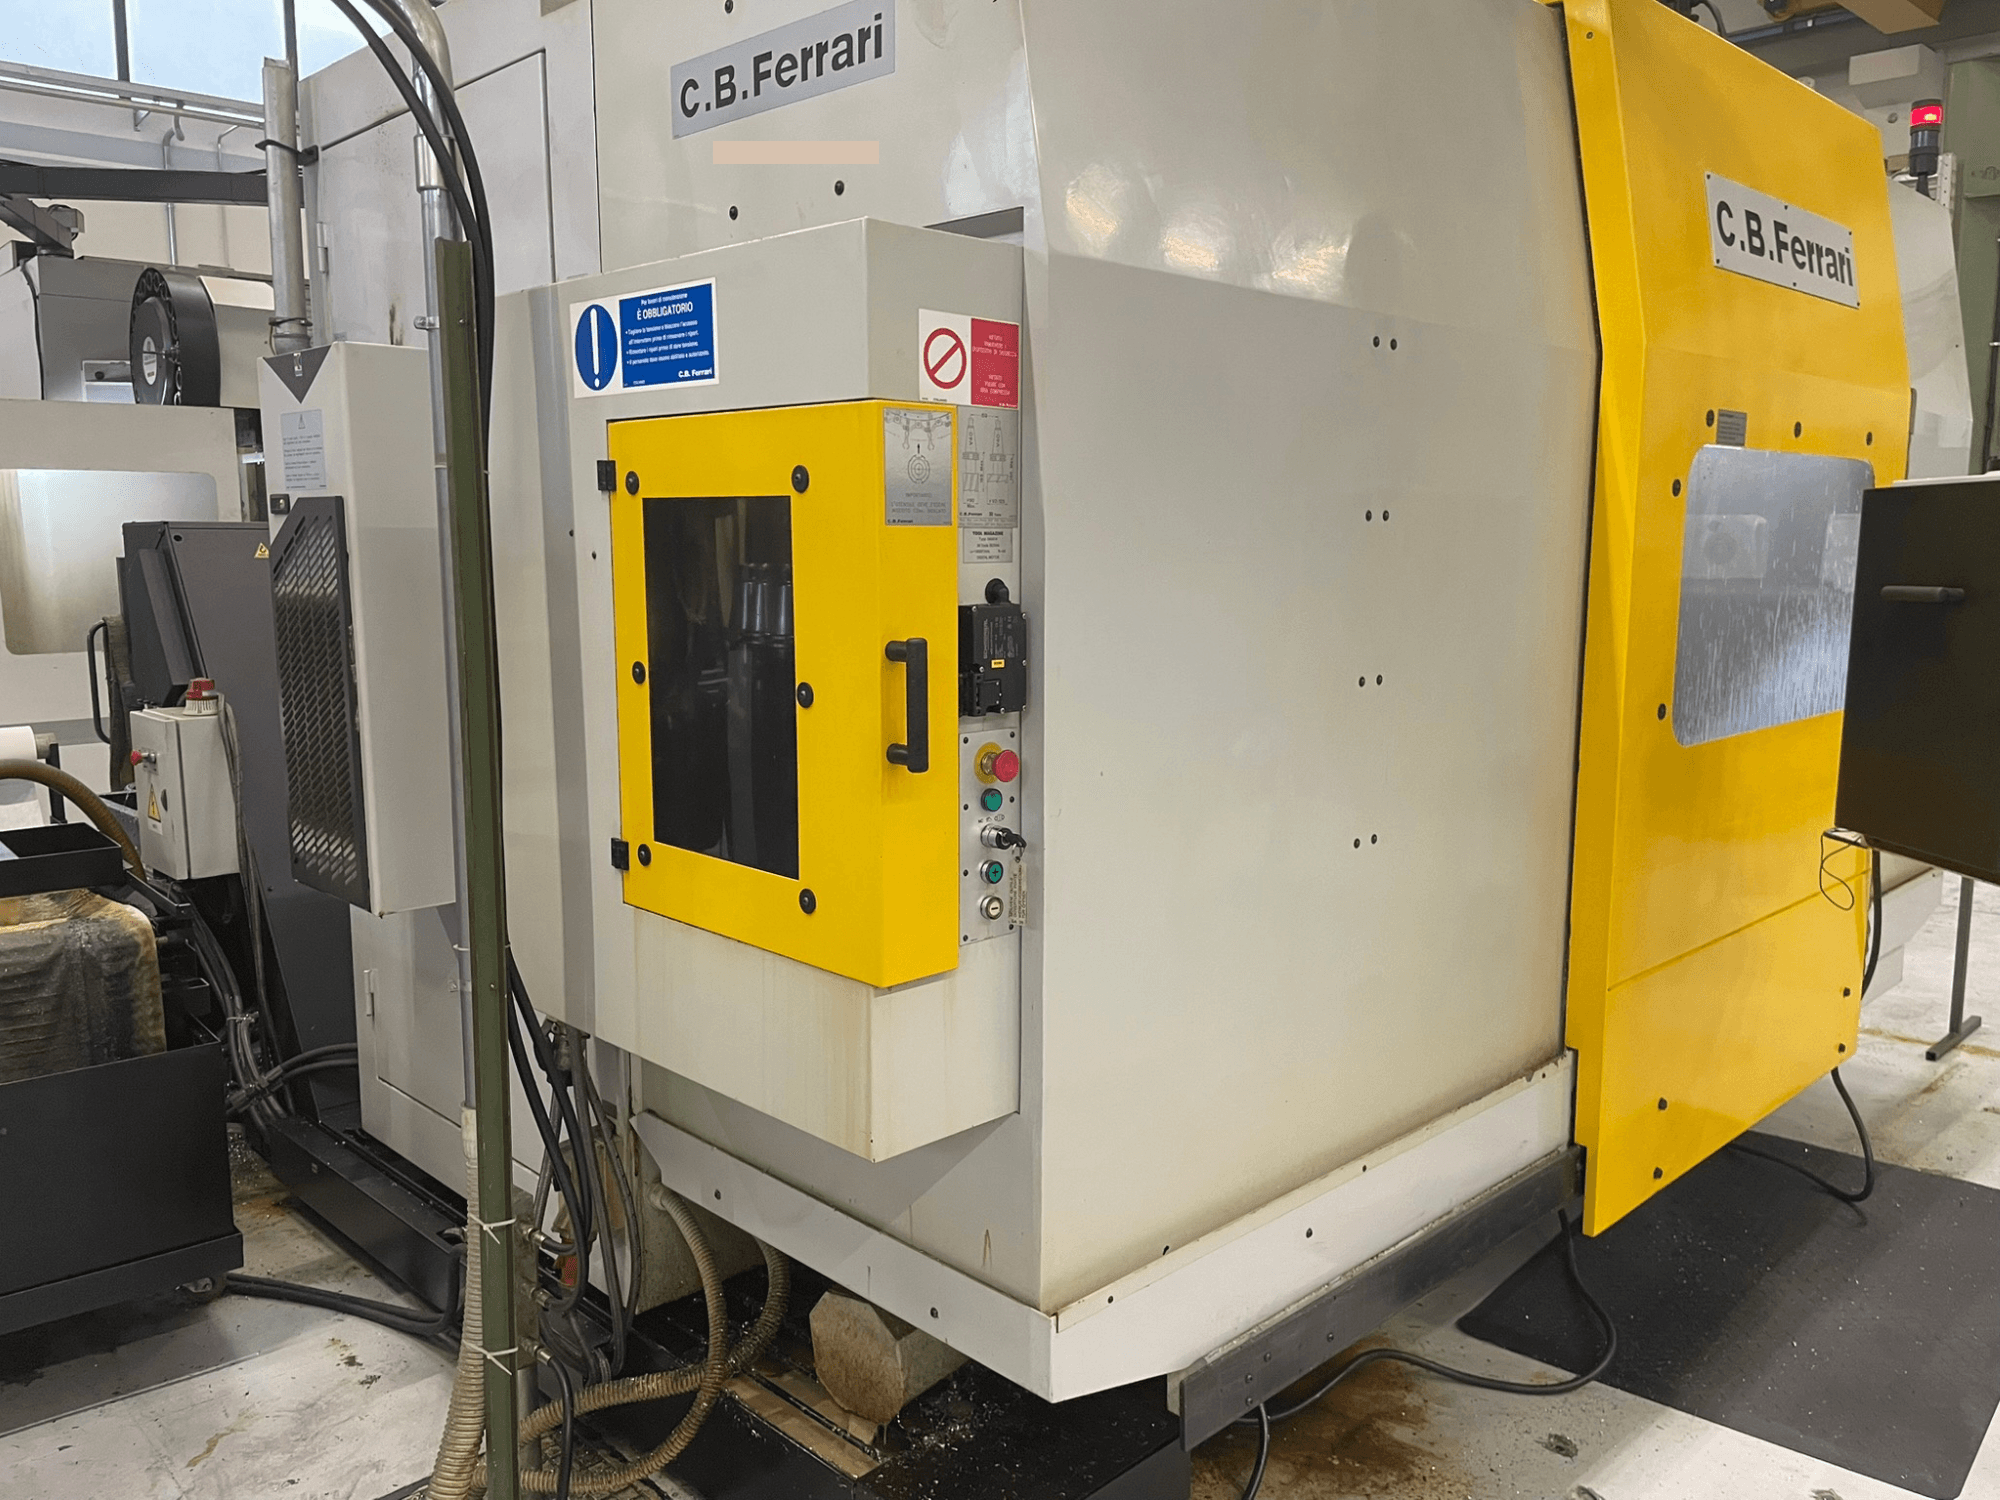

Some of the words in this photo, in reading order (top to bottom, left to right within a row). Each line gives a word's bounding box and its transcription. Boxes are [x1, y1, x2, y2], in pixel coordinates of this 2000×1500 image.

[680, 12, 882, 118] C.B.Ferrari
[1717, 200, 1853, 287] C.B.Ferrari
[636, 307, 642, 320] È
[642, 301, 693, 320] OBBLIGATORIO
[691, 367, 713, 377] Ferrari
